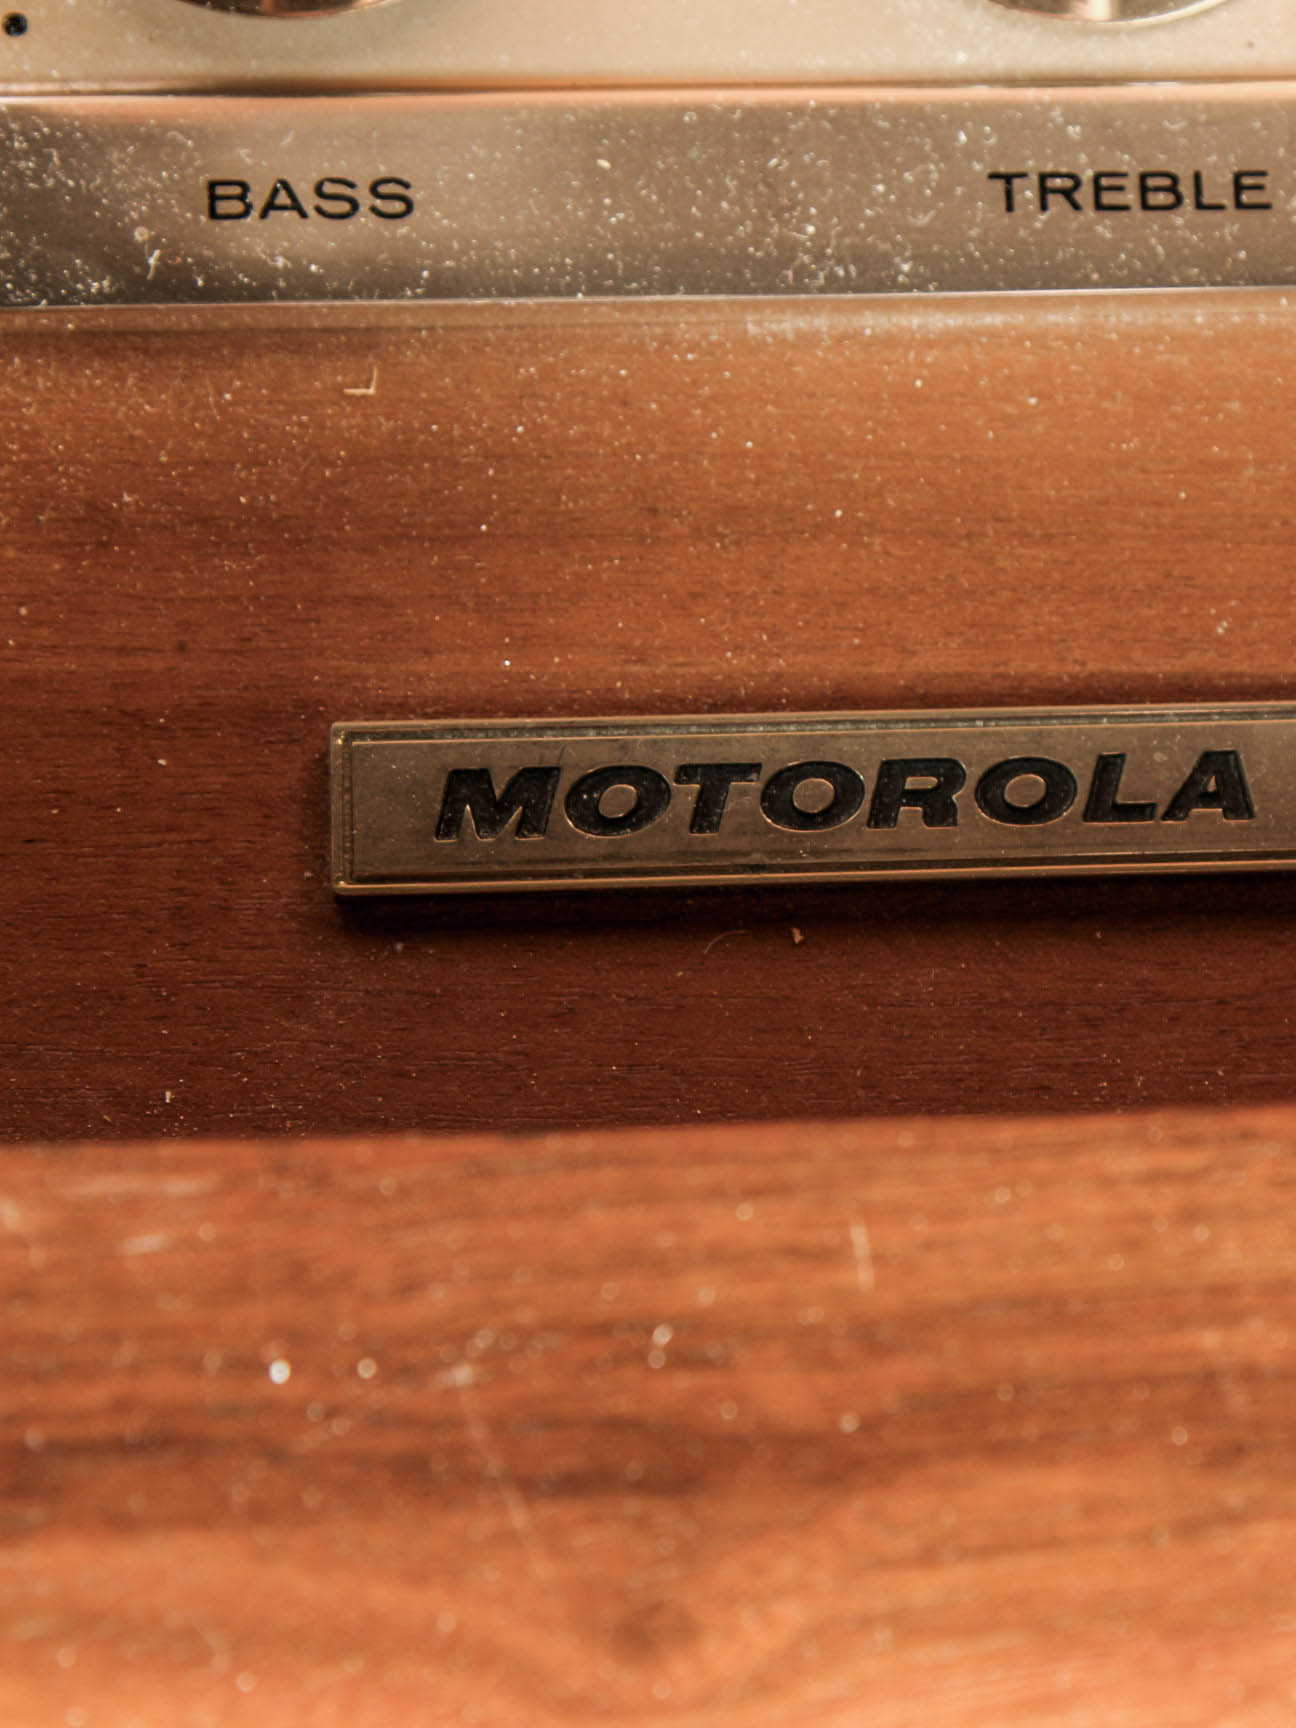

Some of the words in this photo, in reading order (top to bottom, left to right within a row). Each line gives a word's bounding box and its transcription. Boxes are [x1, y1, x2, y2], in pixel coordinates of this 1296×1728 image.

[205, 177, 415, 221] BASS
[987, 170, 1273, 213] TREBLE
[434, 749, 1257, 842] MOTOROLA
